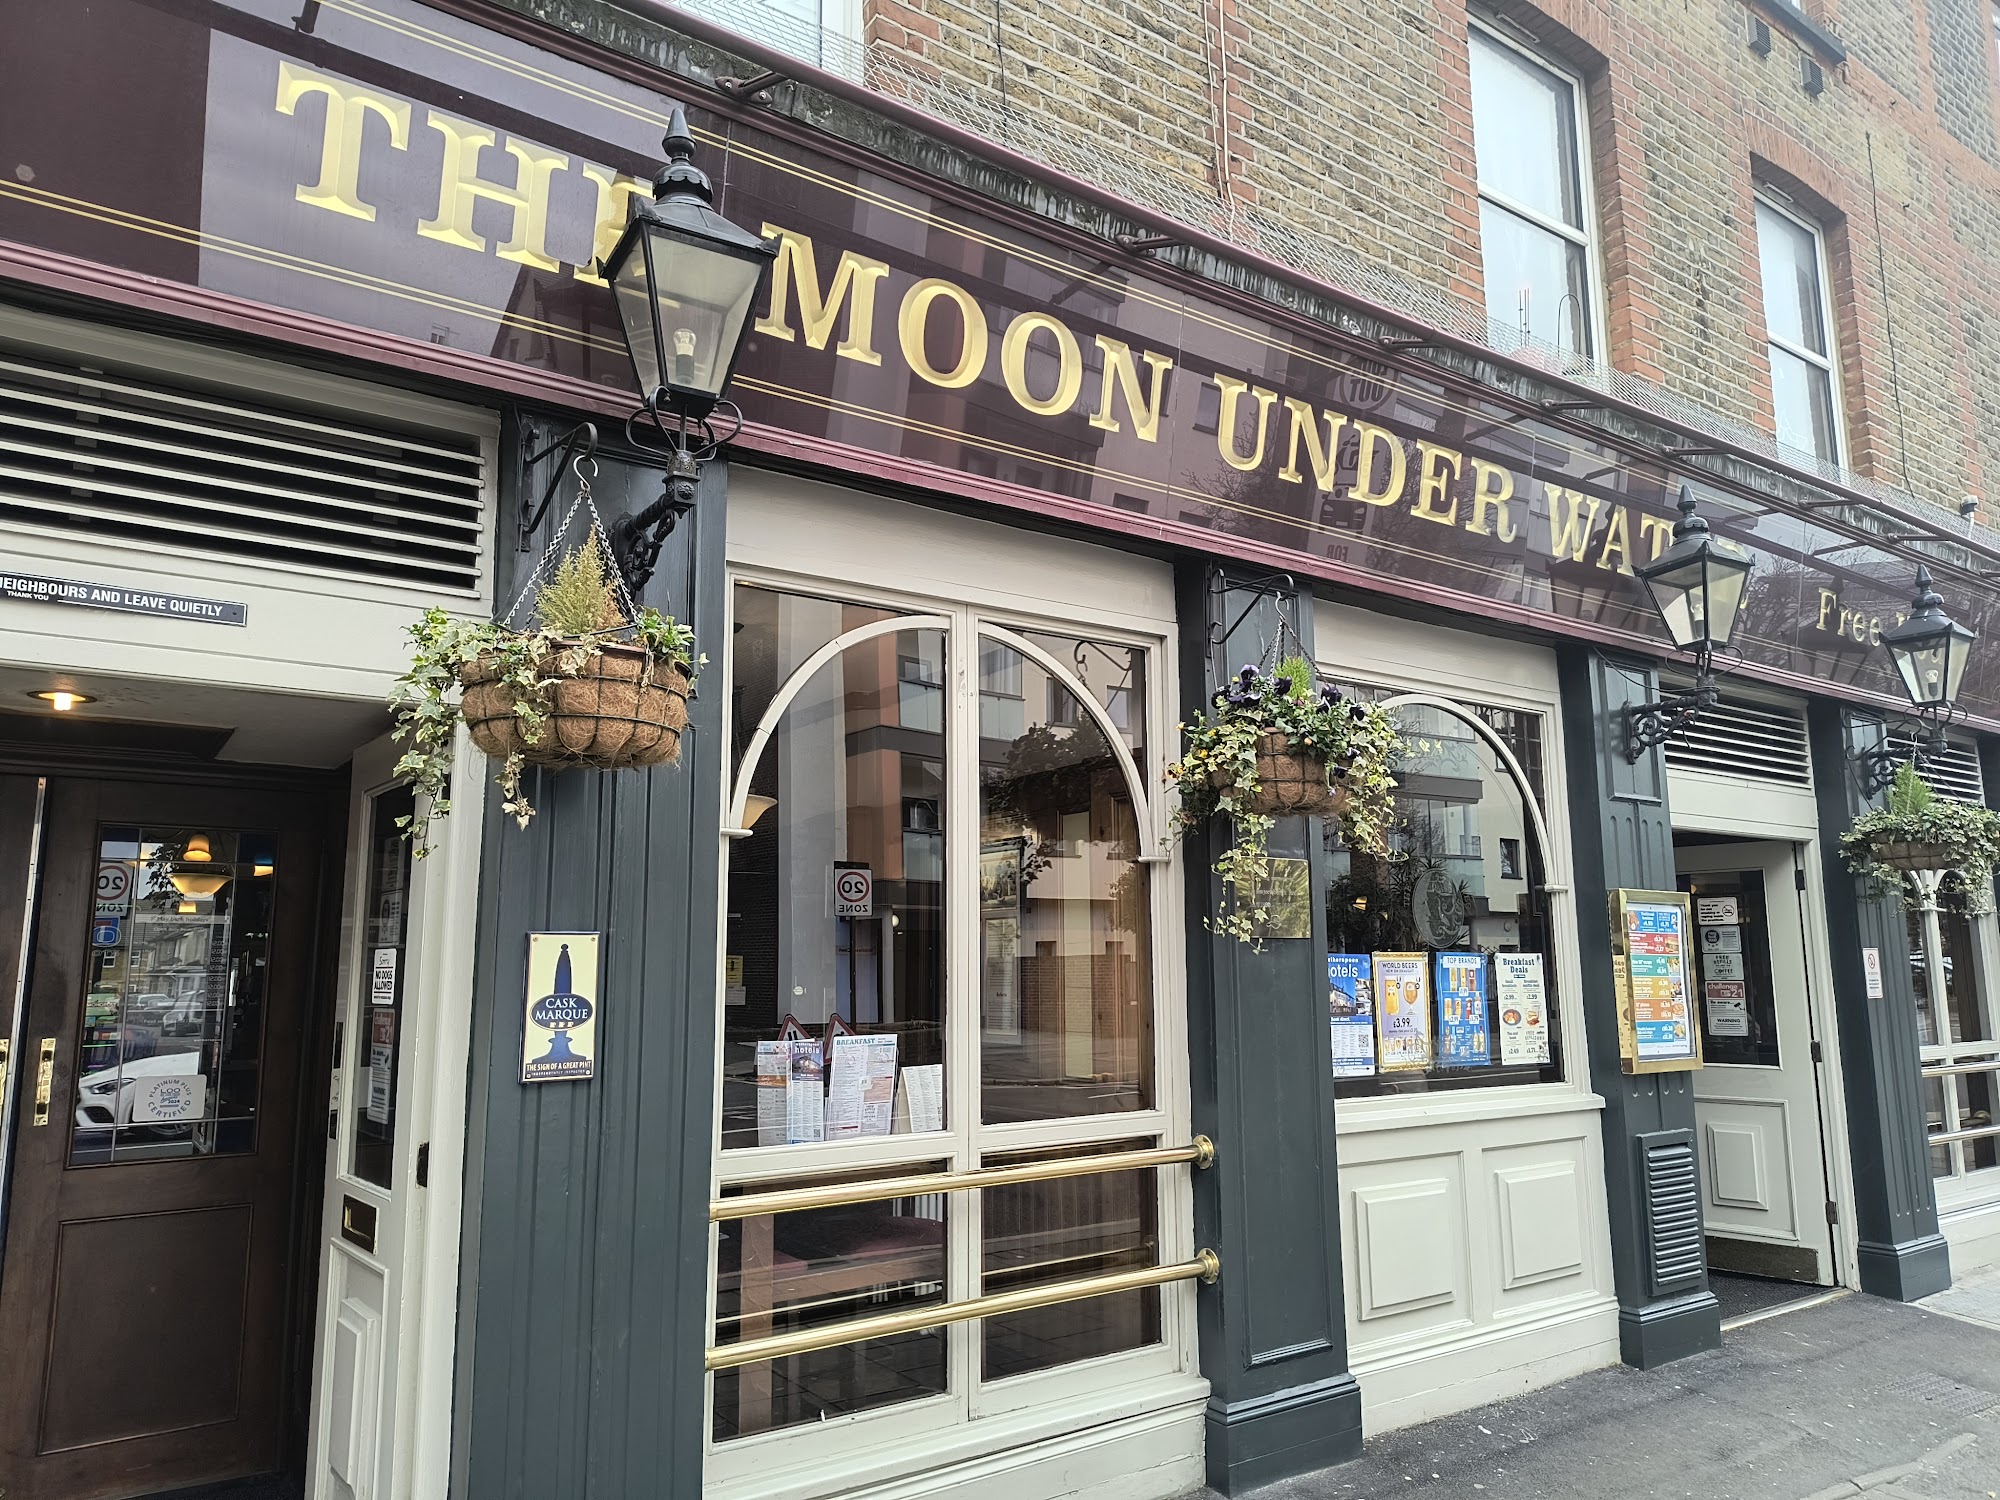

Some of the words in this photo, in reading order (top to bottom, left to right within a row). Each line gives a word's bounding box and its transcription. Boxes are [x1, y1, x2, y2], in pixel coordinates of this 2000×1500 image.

[755, 222, 1173, 444] MOON
[1213, 372, 1518, 544] UNDER
[7, 590, 33, 599] THANK
[33, 593, 49, 601] YOU
[91, 588, 121, 603] AND
[124, 593, 167, 610] LEAVE
[170, 599, 223, 617] QUIETLY
[1458, 957, 1478, 965] BRANDS
[1503, 958, 1535, 966] Breakfast
[376, 970, 382, 980] NO
[382, 970, 393, 980] DOGS
[1328, 964, 1359, 978] otels
[1510, 966, 1529, 974] Deals
[374, 980, 393, 990] ALLOWED
[1708, 983, 1738, 991] challenge
[1731, 988, 1743, 998] 21
[546, 997, 578, 1009] CASK
[535, 1009, 589, 1021] MARQUE
[1393, 1017, 1411, 1028] £3.99
[836, 1038, 875, 1046] BREAKFAST
[795, 1046, 820, 1054] hotels
[527, 1064, 537, 1072] THE
[538, 1063, 551, 1071] SIGN
[563, 1061, 579, 1069] GREAT
[149, 1079, 180, 1098] PLATINUM
[180, 1081, 192, 1096] PLUS
[148, 1100, 191, 1118] CERTIFIED
